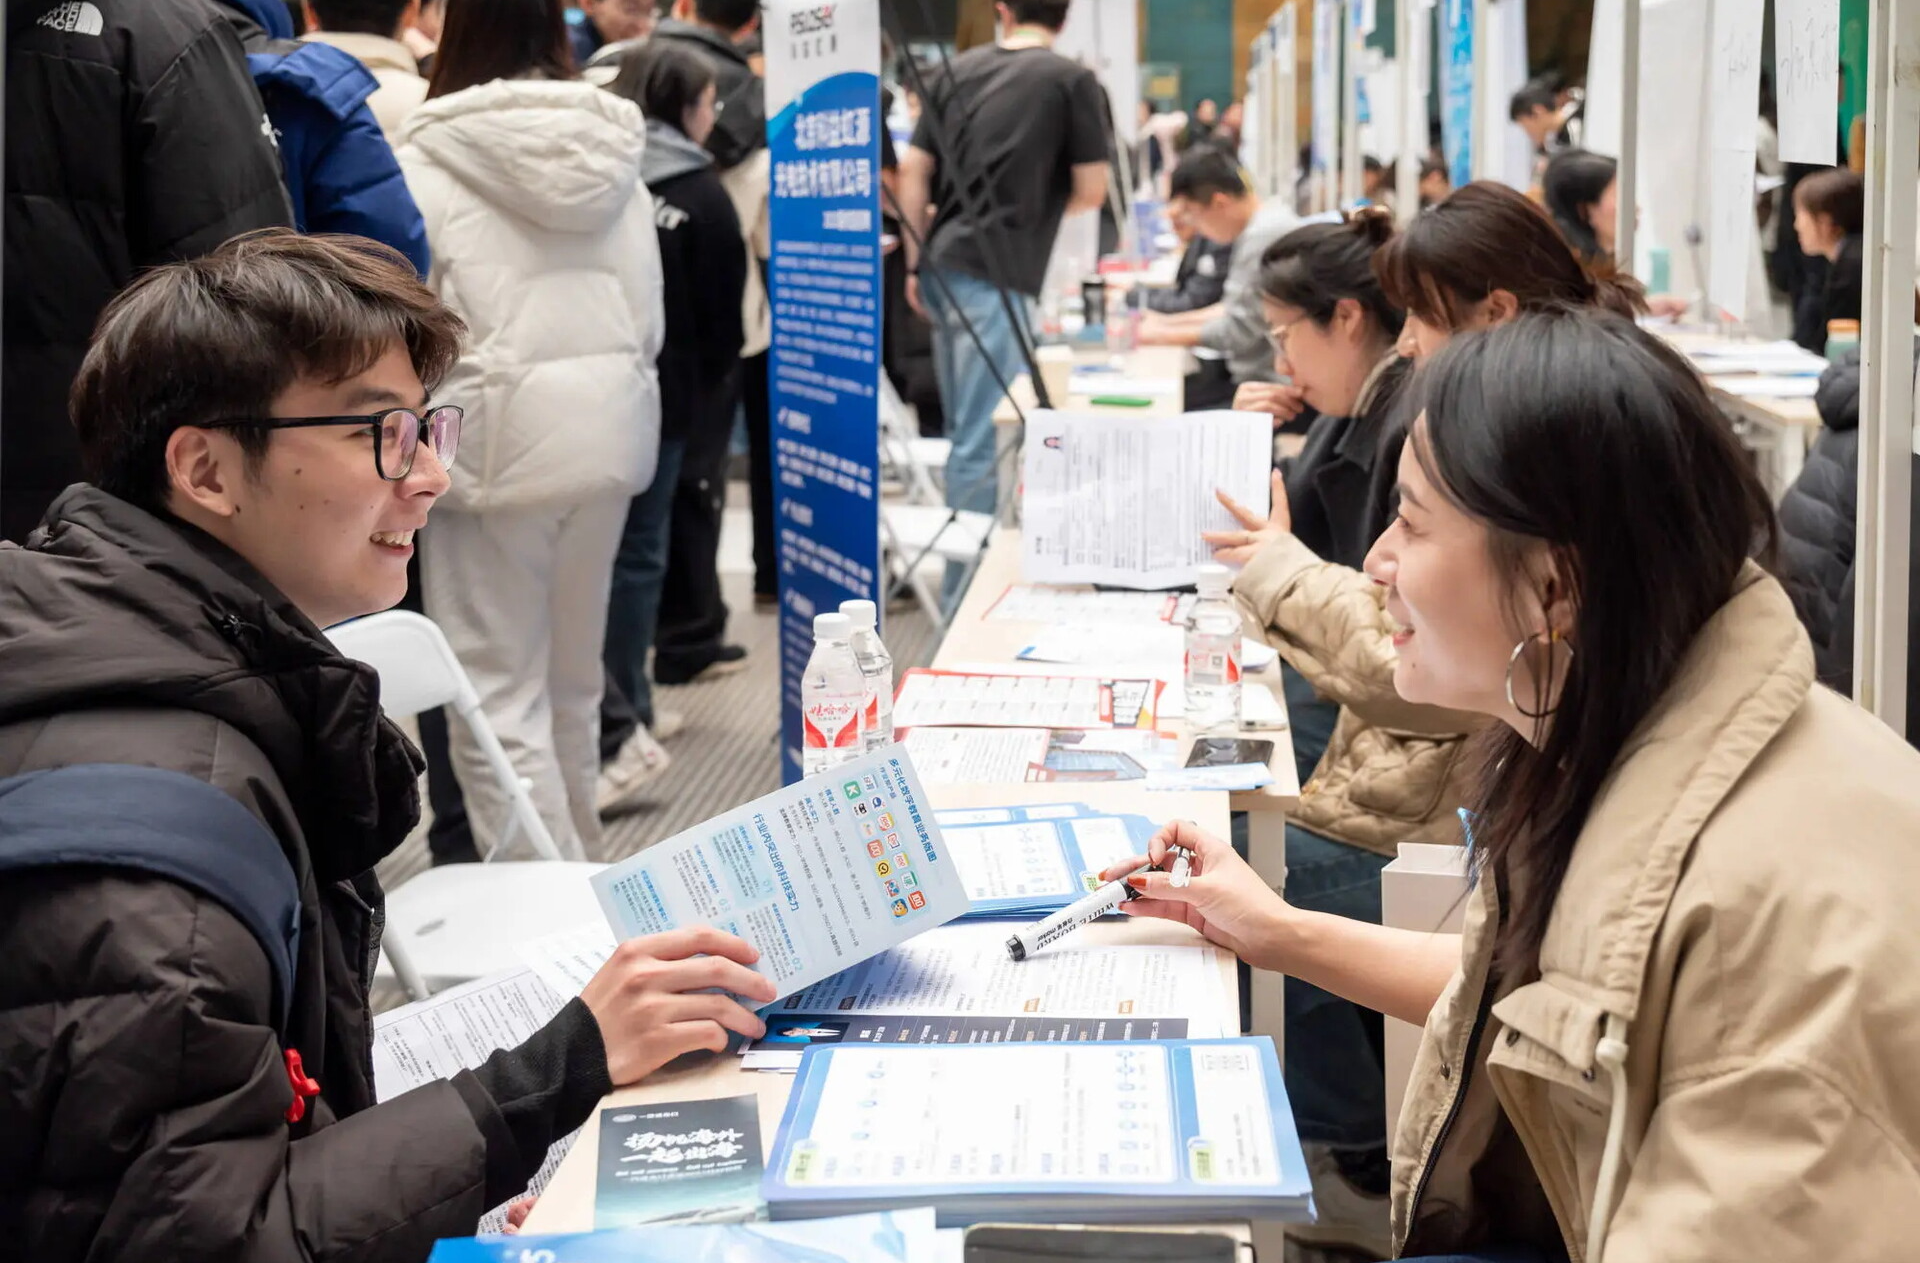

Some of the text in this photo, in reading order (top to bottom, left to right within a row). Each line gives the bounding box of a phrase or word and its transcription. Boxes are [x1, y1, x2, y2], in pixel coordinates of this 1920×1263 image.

[36, 15, 75, 32] FACE
[809, 703, 850, 717] 娃哈哈
[888, 758, 935, 862] 多元化数字教育业务版图
[752, 813, 800, 911] 行业内突出的科技实力
[911, 892, 922, 907] 100
[1037, 927, 1057, 942] marker
